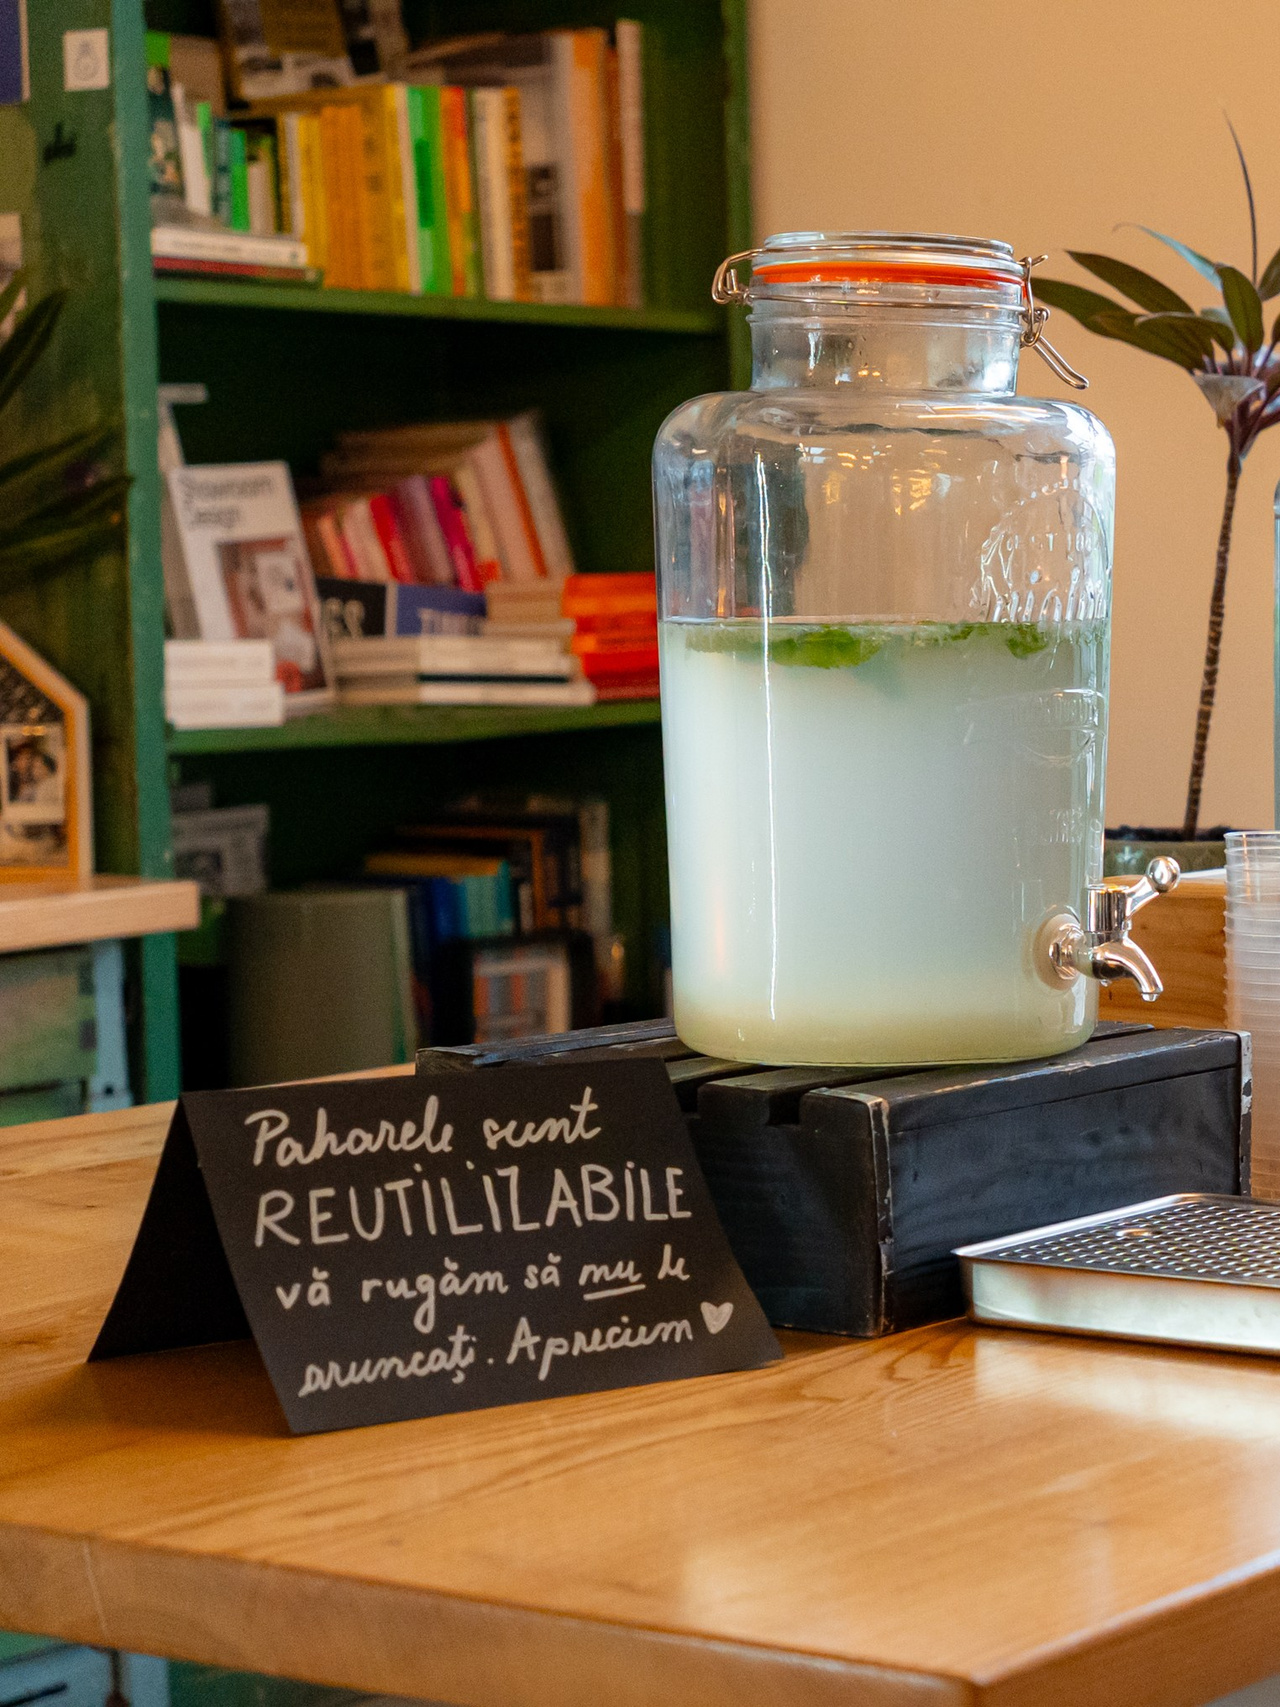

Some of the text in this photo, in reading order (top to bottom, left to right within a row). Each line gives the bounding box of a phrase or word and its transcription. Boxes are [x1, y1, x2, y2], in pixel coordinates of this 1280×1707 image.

[244, 1085, 602, 1168] Paharele sunt
[253, 1160, 693, 1249] REUTILIZABILE
[275, 1266, 331, 1311] vă
[360, 1256, 509, 1334] rugăm
[524, 1252, 562, 1290] să
[657, 1243, 691, 1281] le
[506, 1314, 694, 1382] Apreciem
